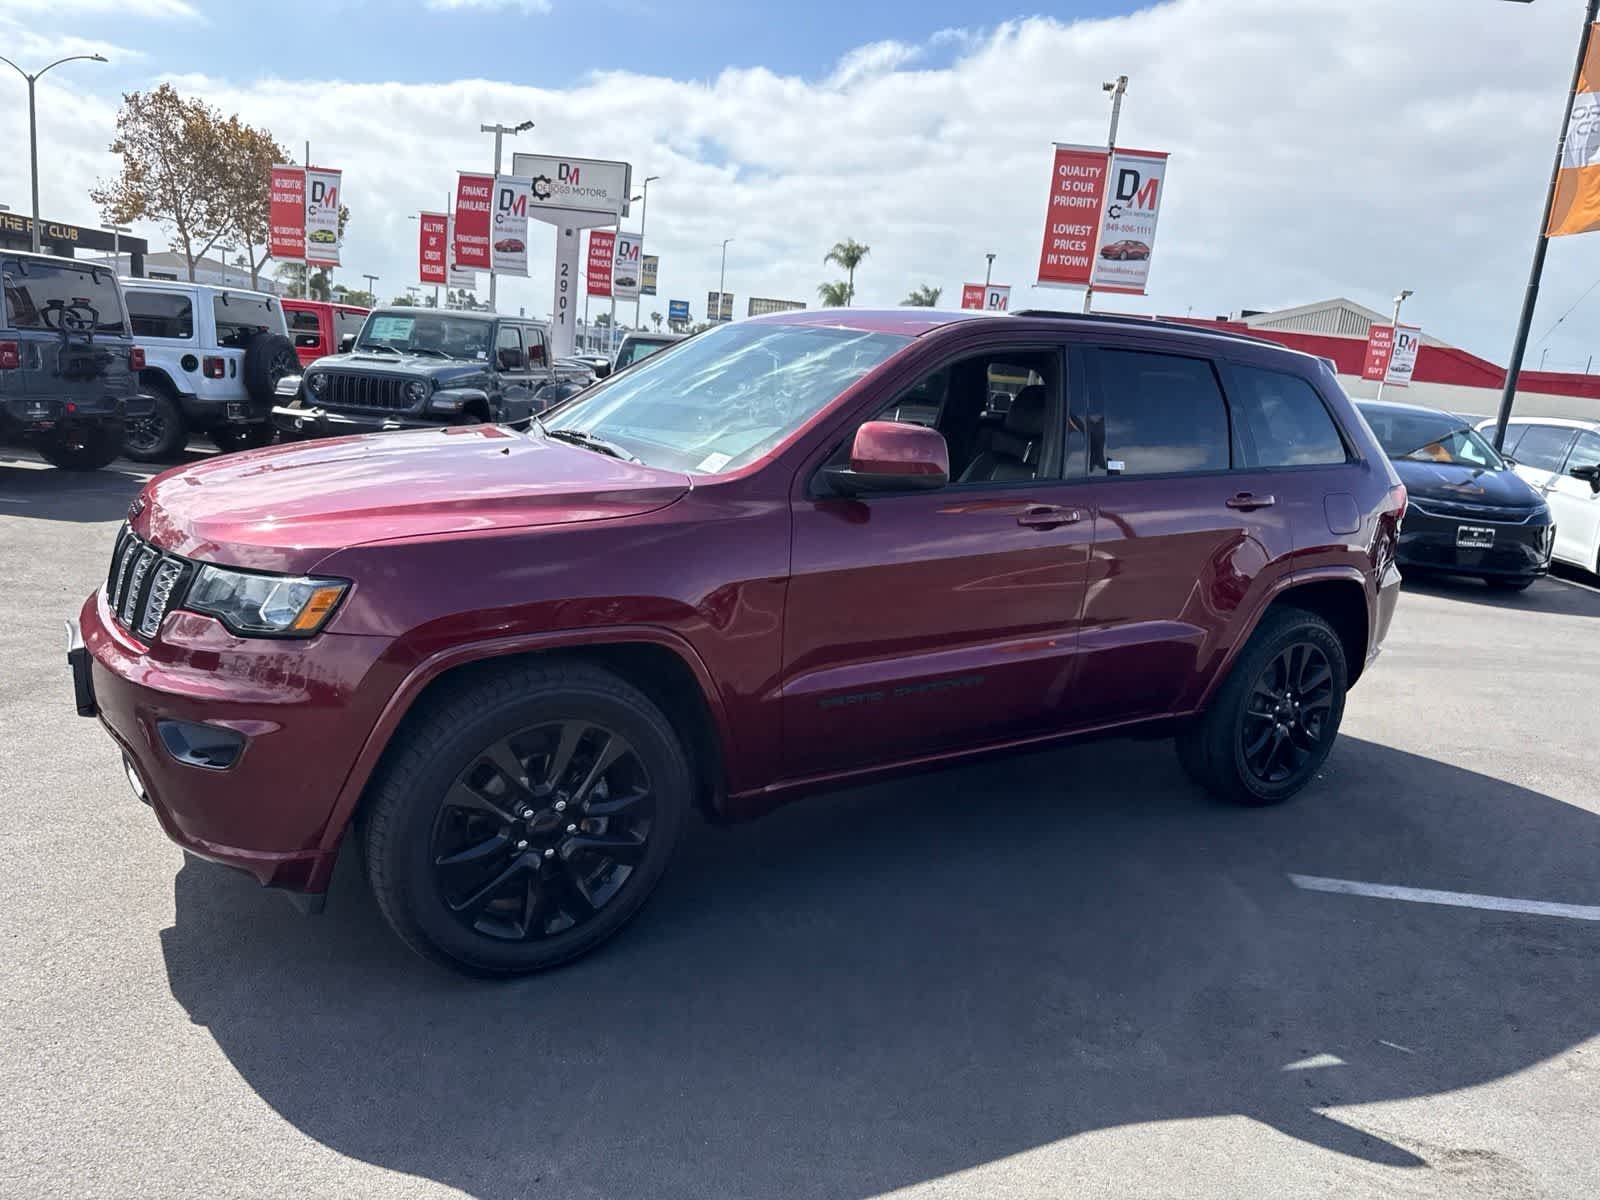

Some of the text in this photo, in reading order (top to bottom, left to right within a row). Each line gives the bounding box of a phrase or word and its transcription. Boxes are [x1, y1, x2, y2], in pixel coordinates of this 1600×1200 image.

[1059, 165, 1101, 178] QUALITY
[462, 185, 488, 197] FINANCE
[572, 186, 607, 198] MOTORS
[1062, 181, 1094, 193] IS OUR
[458, 199, 490, 212] AVAILABLE
[1053, 195, 1099, 209] PRIORITY
[27, 219, 47, 236] FT
[48, 224, 79, 241] CLUB
[1053, 223, 1092, 237] LOWEST
[1053, 239, 1087, 251] PRICES
[591, 247, 604, 257] CARS
[590, 257, 611, 268] TRUCKS
[1047, 254, 1088, 267] IN TOWN
[558, 263, 569, 325] 2901
